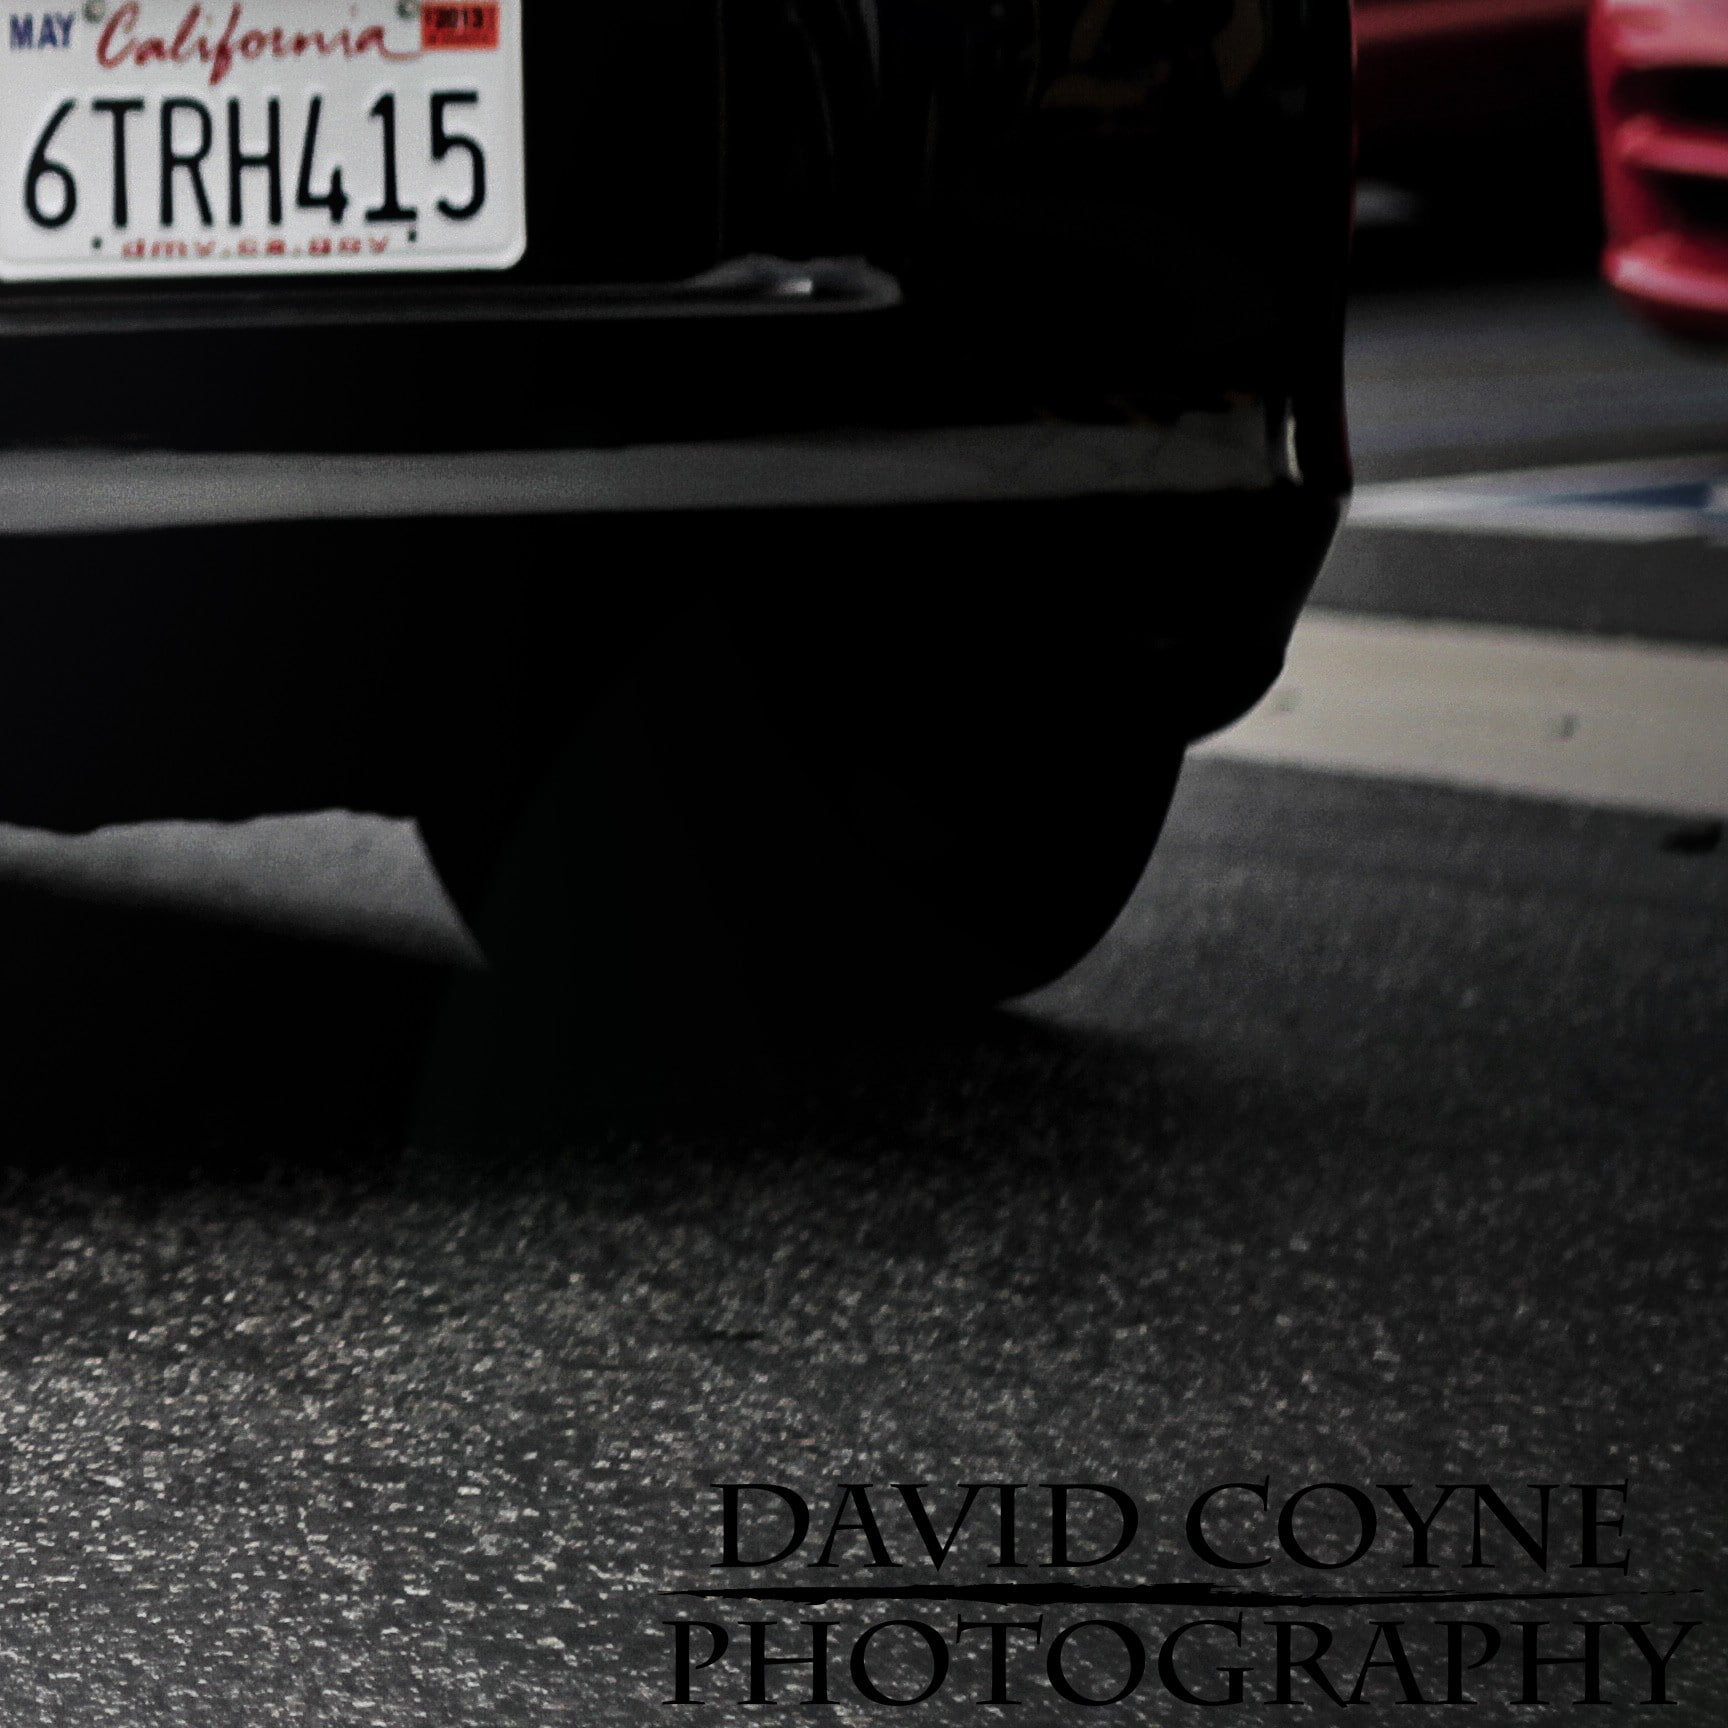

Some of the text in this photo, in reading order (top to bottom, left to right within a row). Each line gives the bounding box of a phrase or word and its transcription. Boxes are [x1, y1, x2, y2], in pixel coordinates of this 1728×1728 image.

[9, 12, 76, 50] MAY
[96, 0, 424, 86] California
[23, 89, 487, 230] 6TRH415
